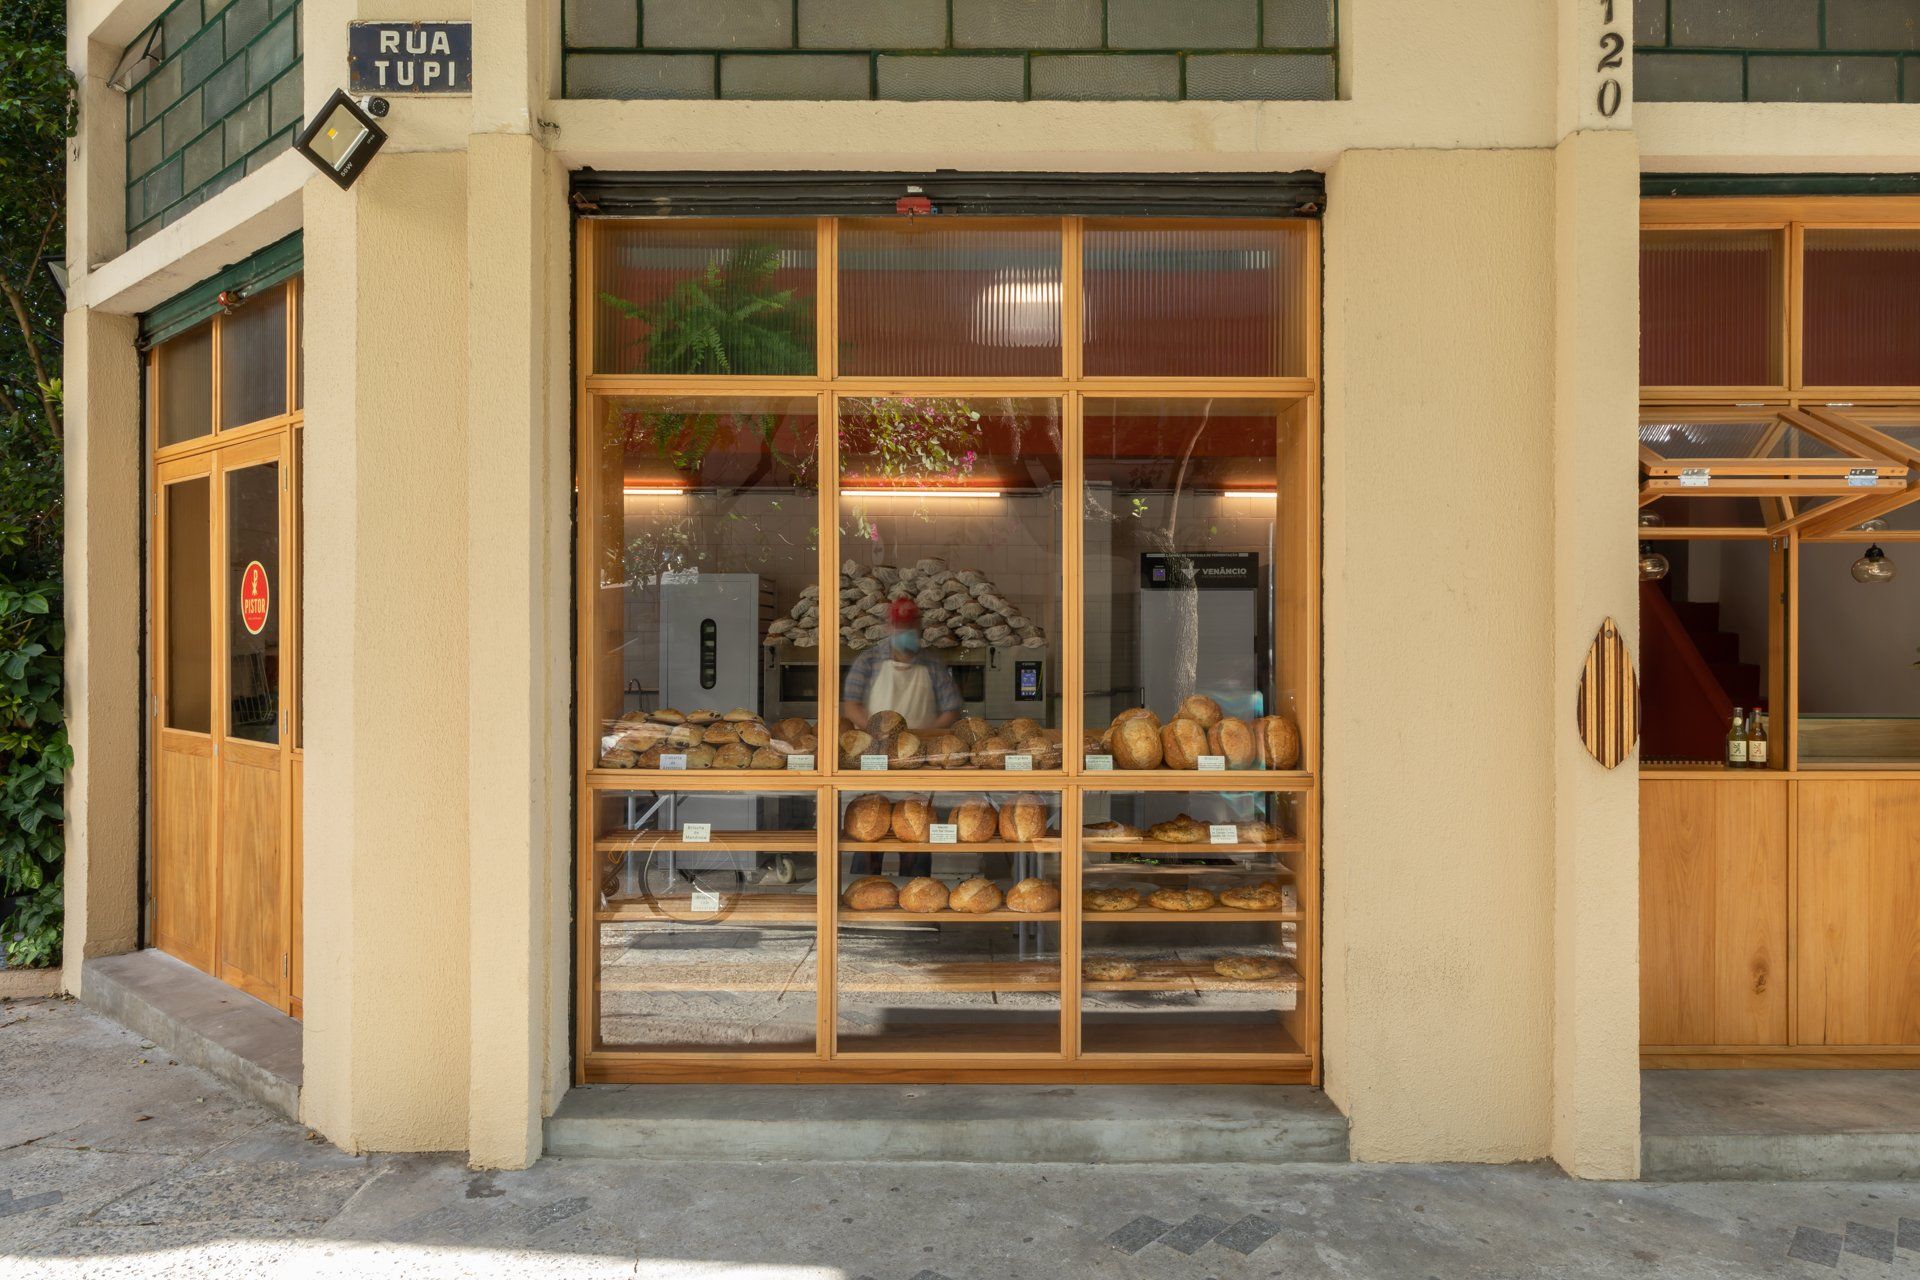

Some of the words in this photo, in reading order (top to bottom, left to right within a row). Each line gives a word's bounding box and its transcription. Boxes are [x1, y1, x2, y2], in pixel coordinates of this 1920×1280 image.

[380, 30, 451, 55] RUA
[374, 60, 456, 87] TUPI
[1202, 567, 1247, 575] VENÂNCIO
[244, 598, 266, 614] PISTOR
